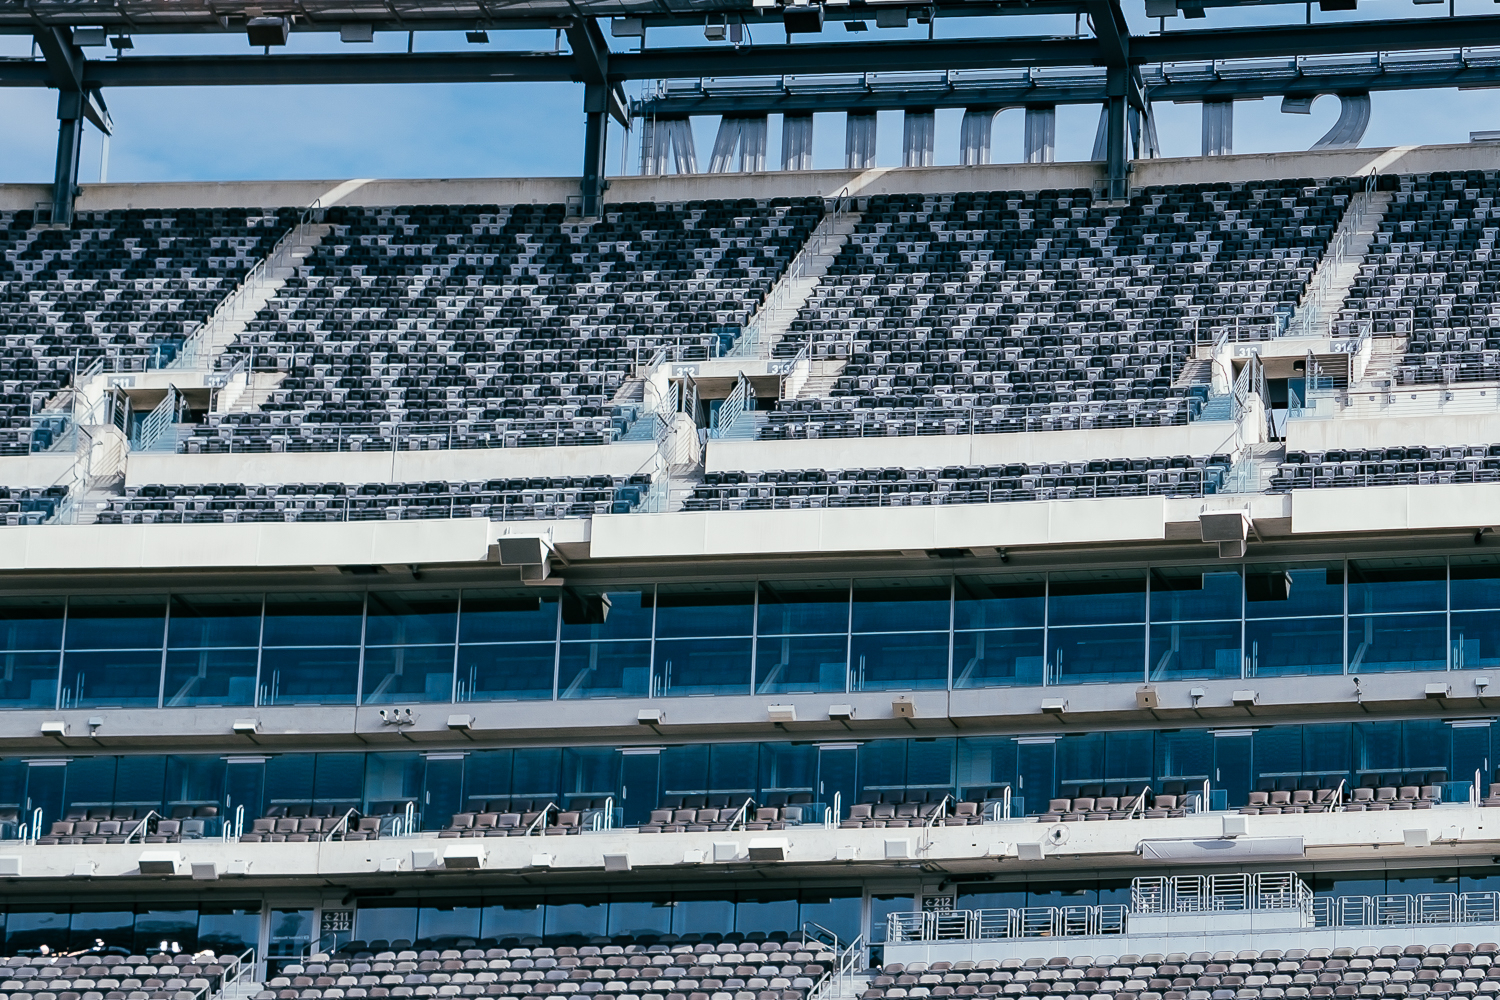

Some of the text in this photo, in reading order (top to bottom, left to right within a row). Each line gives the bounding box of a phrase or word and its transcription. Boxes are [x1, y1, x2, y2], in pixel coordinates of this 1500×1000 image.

[933, 898, 951, 907] 212
[333, 912, 349, 921] 211
[332, 922, 350, 931] 212
